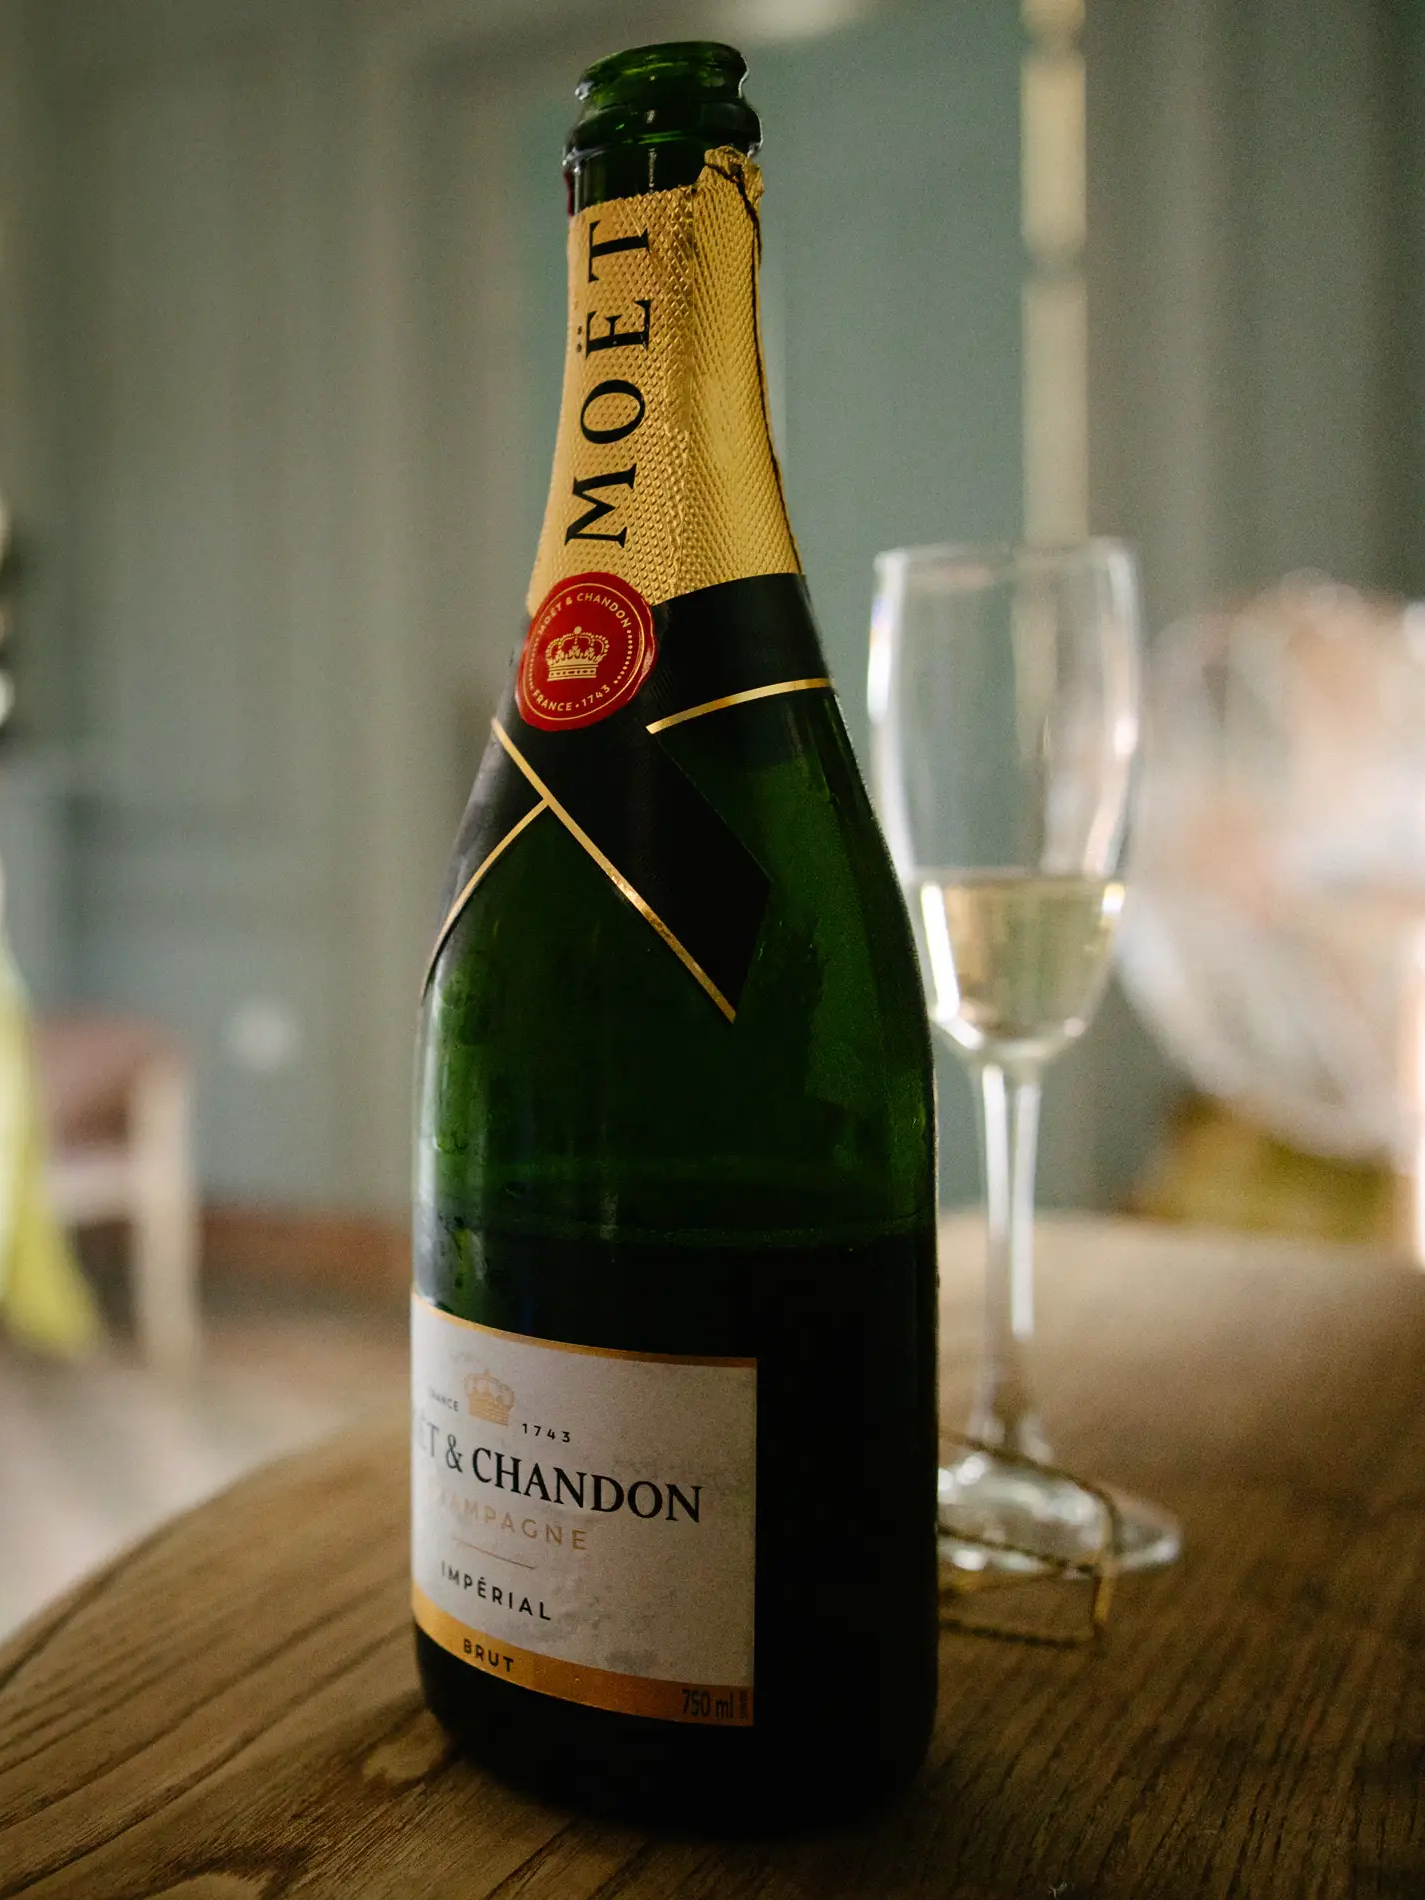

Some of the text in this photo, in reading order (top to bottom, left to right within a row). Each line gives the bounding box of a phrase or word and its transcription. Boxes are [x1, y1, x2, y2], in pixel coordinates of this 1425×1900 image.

[564, 219, 650, 549] MOËT
[577, 592, 632, 628] CHANDON
[533, 684, 611, 712] FRANCE 1743
[522, 1423, 571, 1444] 1743
[446, 1434, 464, 1474] &
[472, 1447, 704, 1523] CHANDON
[441, 1560, 551, 1621] IMPÉRIAL
[464, 1638, 514, 1673] BRUT
[681, 1688, 711, 1717] 750
[715, 1691, 734, 1720] ml
